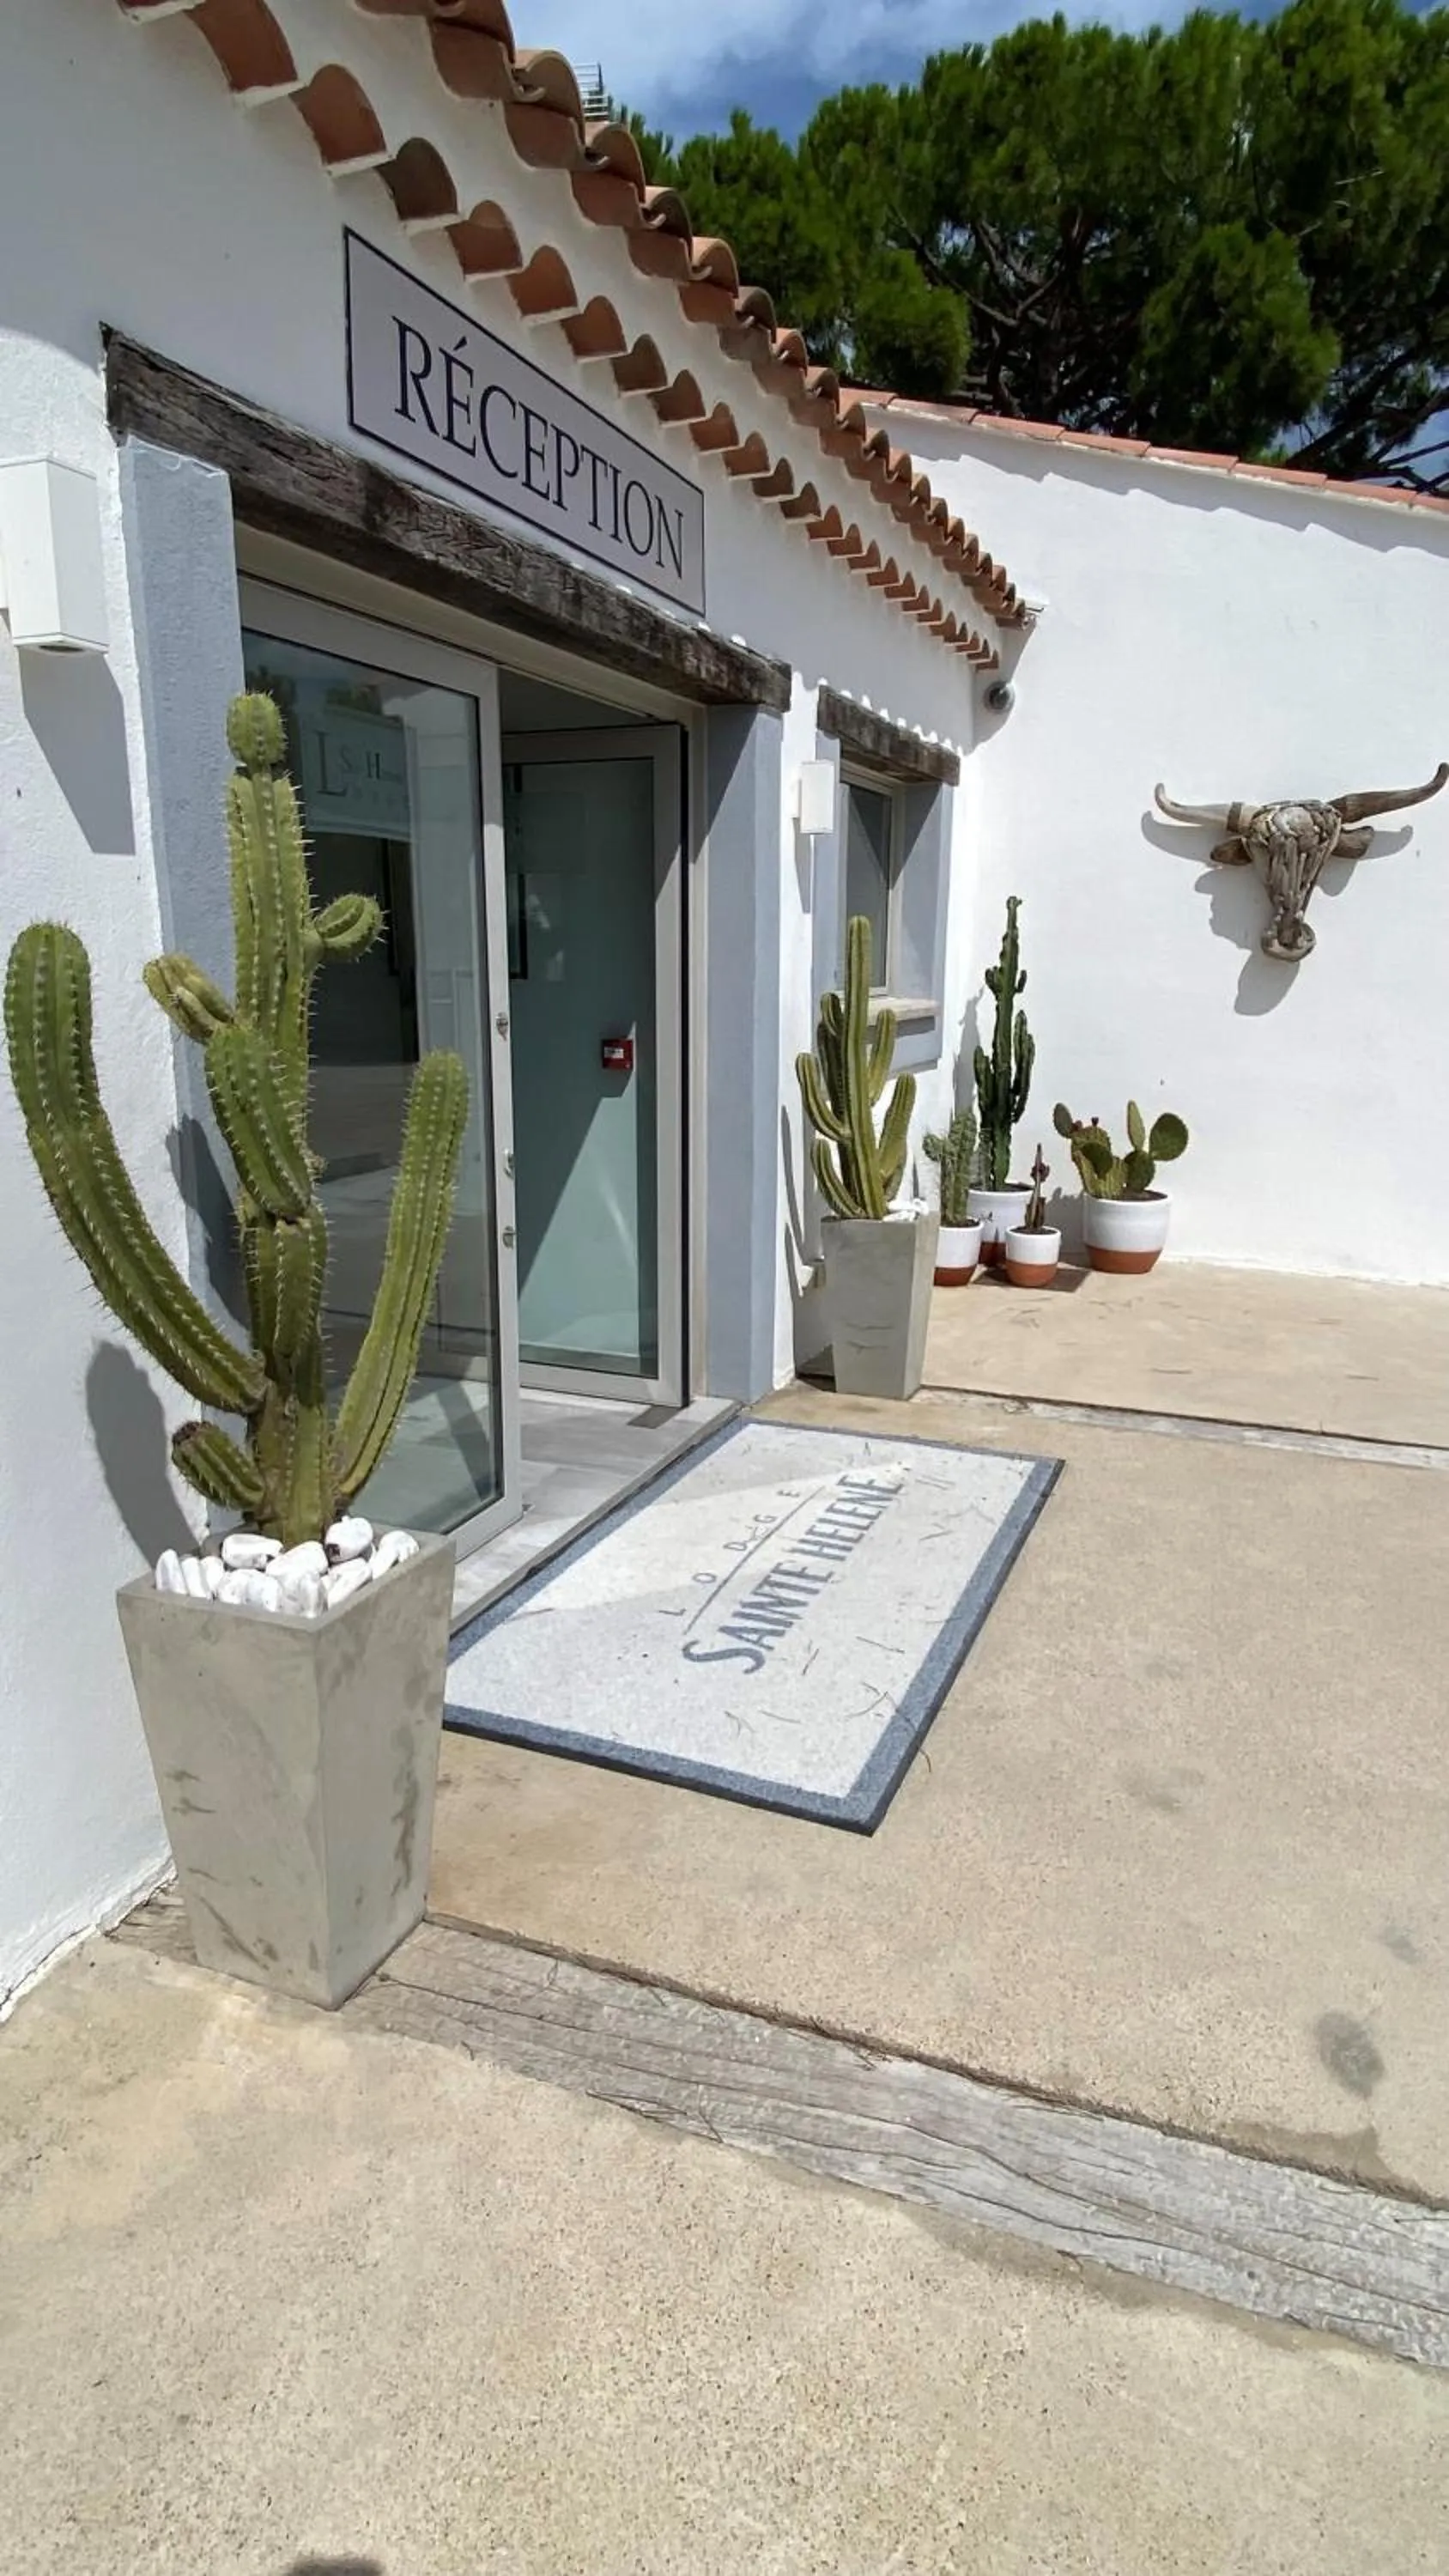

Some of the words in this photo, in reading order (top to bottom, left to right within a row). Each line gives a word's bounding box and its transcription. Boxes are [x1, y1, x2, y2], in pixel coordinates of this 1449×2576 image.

[391, 315, 684, 580] RÉCEPTION
[658, 1489, 800, 1617] LODGE
[682, 1559, 835, 1675] SAINTE
[783, 1474, 904, 1562] HELENE
